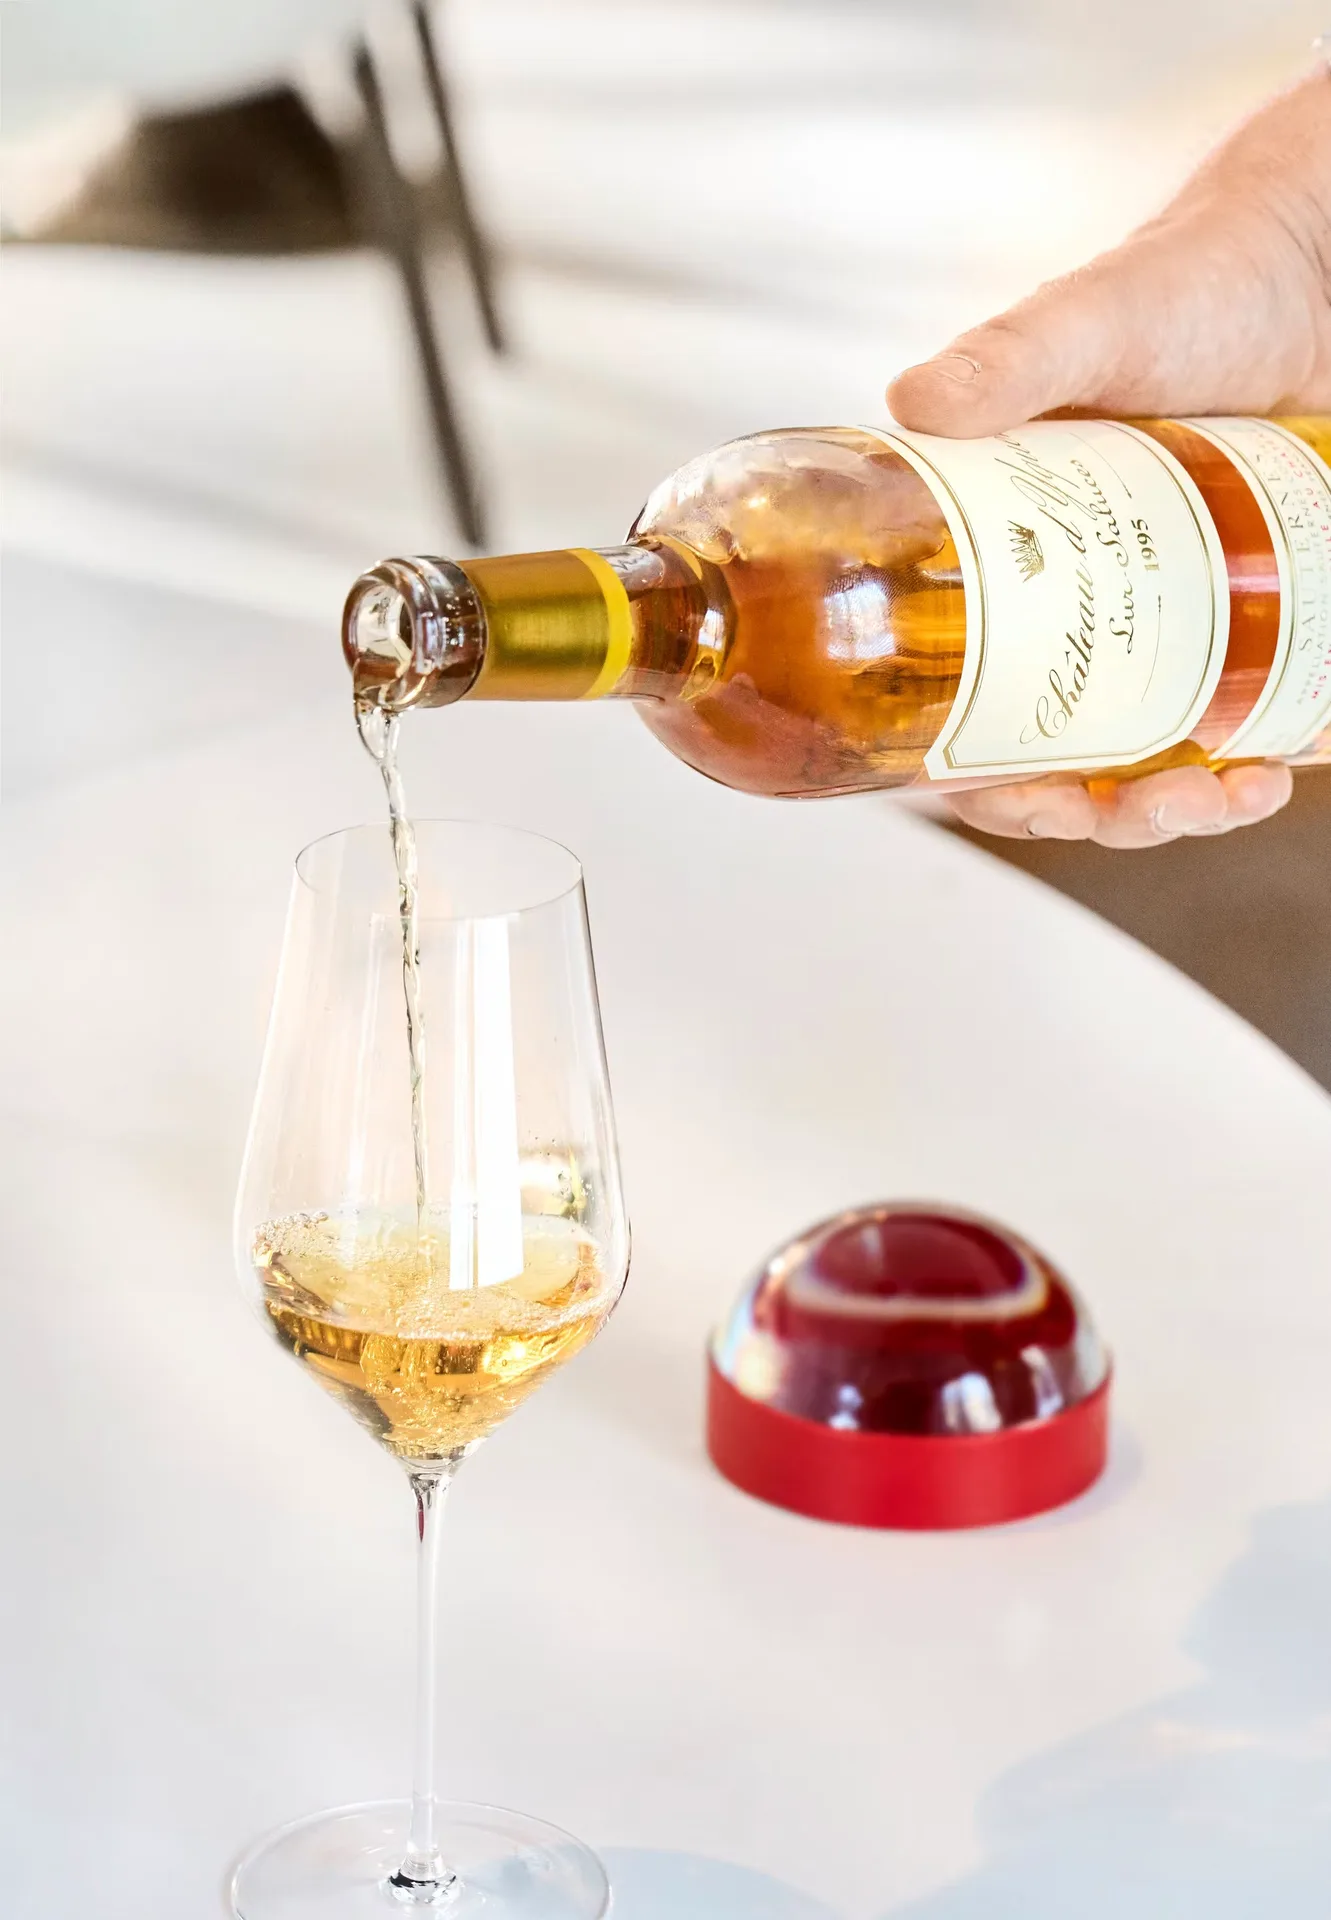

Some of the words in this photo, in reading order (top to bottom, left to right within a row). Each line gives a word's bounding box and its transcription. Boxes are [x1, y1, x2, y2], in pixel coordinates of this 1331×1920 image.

[994, 432, 1097, 560] d'Yque
[1130, 518, 1160, 572] 1995
[1254, 452, 1315, 652] SAUTERNES
[1020, 562, 1095, 744] Château
